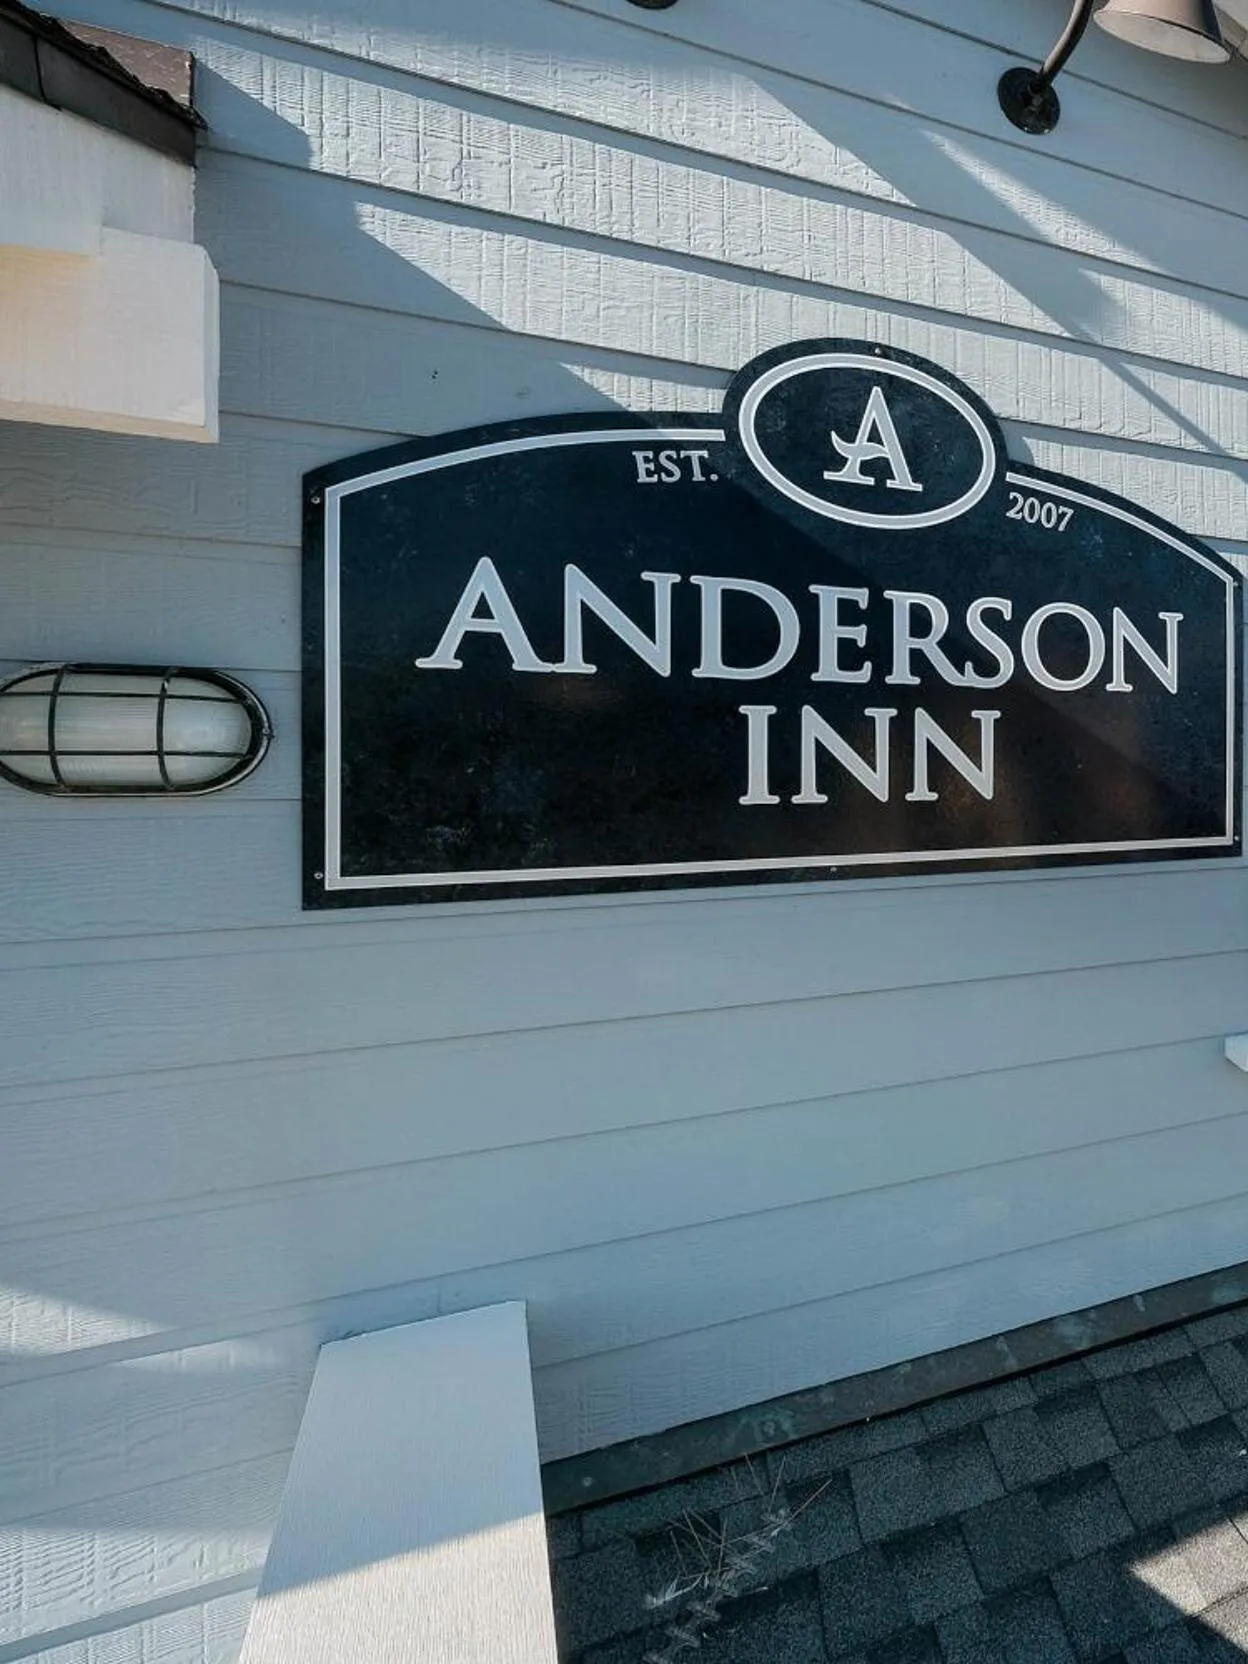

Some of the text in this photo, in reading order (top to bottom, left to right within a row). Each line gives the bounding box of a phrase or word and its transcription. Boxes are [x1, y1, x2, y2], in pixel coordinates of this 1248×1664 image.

[632, 449, 1075, 532] EST. 2007
[823, 386, 923, 492] A
[414, 556, 1184, 695] ANDERSON
[738, 704, 1002, 806] INN
